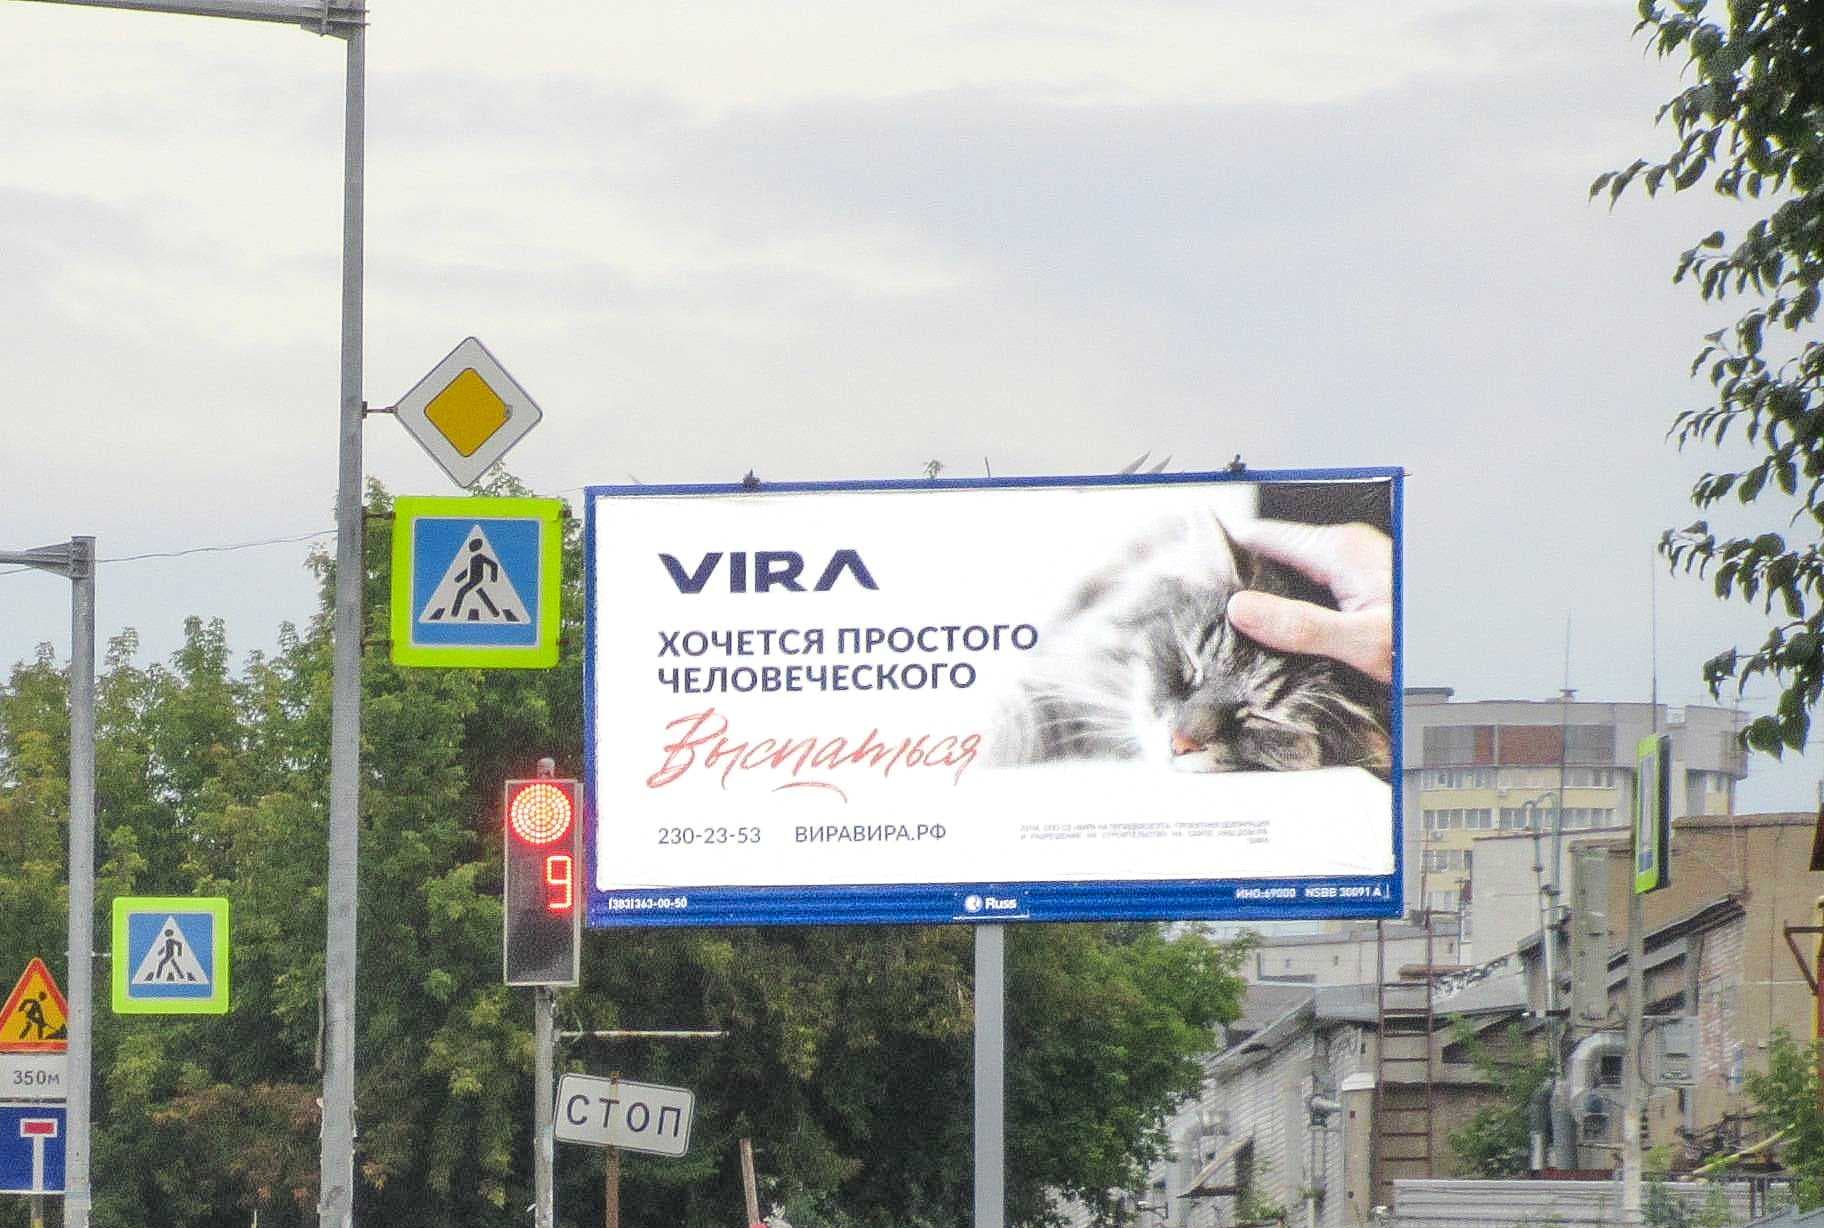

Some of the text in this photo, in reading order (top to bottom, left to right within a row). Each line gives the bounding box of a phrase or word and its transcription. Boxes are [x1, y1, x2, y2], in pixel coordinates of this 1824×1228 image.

[657, 549, 881, 595] VIRA
[657, 623, 1039, 658] ХОЧЕТСЯ ПРОСТОГО
[657, 662, 977, 694] ЧЕЛОВЕЧЕСКОГО
[646, 707, 982, 791] Выспаться
[657, 822, 947, 845] 230-23-53 ВИРАВИРА.РФ
[546, 854, 573, 909] 9
[984, 896, 1018, 910] Russ
[566, 1094, 682, 1138] СТОП
